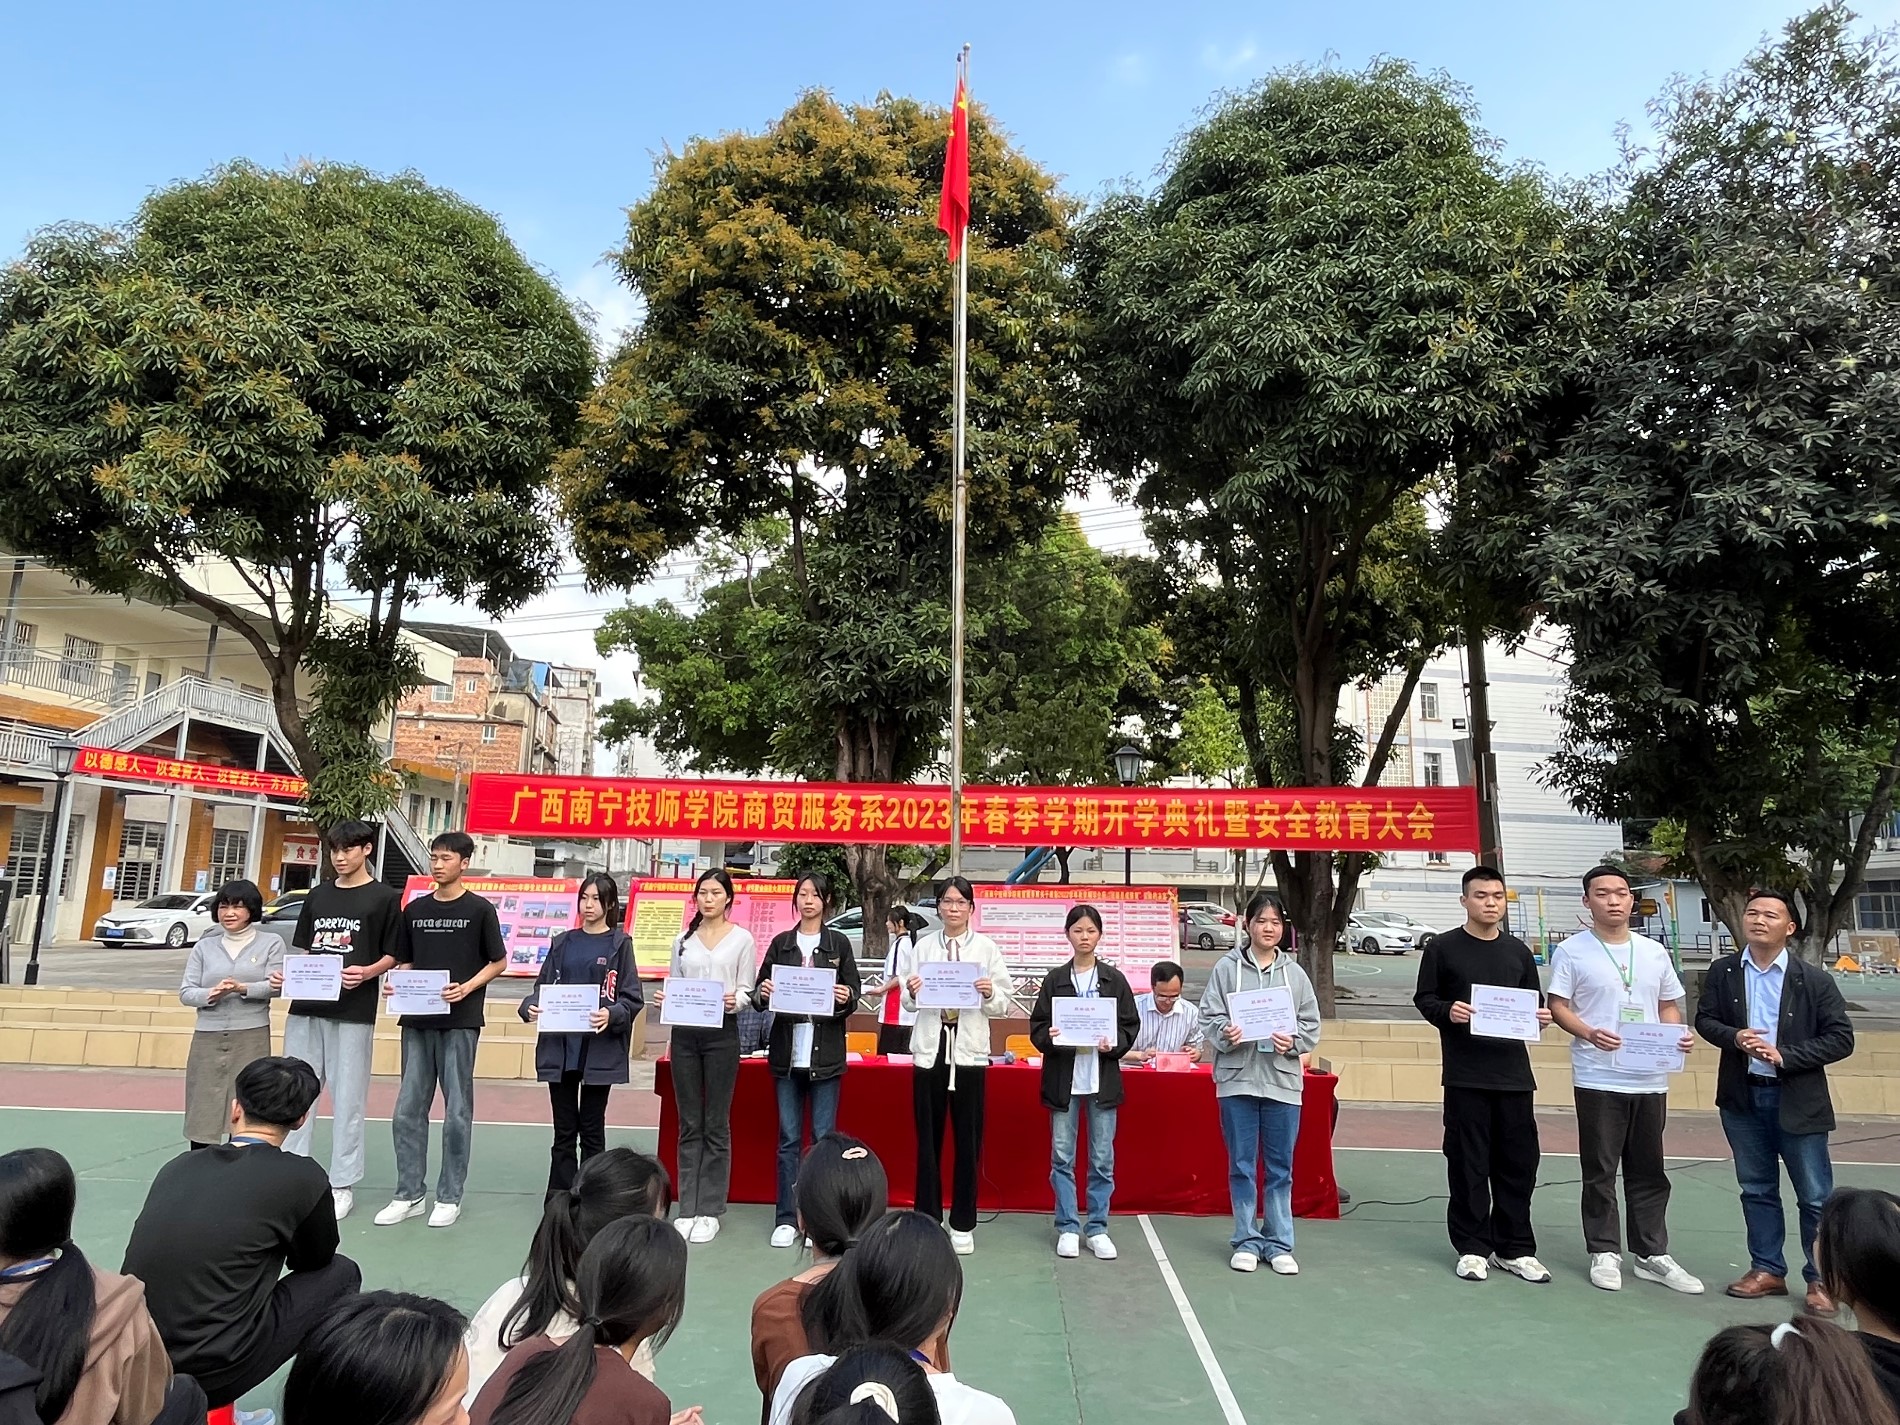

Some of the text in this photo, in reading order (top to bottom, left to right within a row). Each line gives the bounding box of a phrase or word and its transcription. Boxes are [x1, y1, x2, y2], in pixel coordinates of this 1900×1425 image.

[509, 785, 1435, 840] 广西南宁技师学院商贸服务系2023年春季学期开学典礼暨安全教育大会
[296, 845, 318, 860] 食堂
